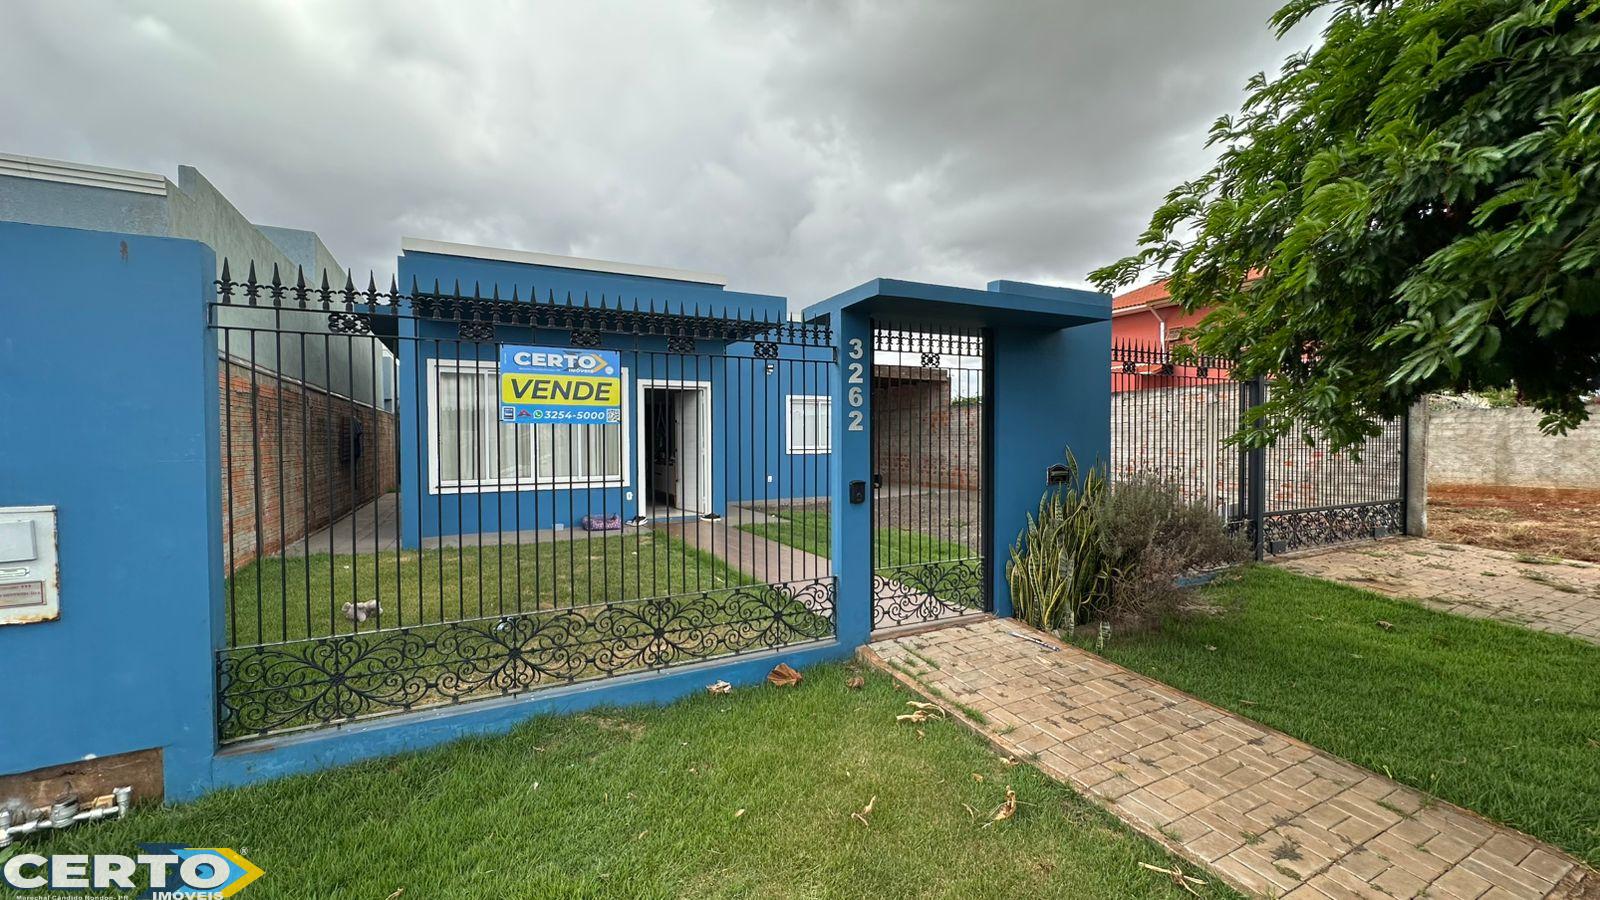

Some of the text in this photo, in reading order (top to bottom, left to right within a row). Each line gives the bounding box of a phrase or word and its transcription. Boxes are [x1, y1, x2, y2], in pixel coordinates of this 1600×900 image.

[513, 351, 597, 369] CERTO
[511, 378, 613, 401] VENDE
[848, 338, 864, 431] 3262
[544, 410, 605, 420] 3254-5000
